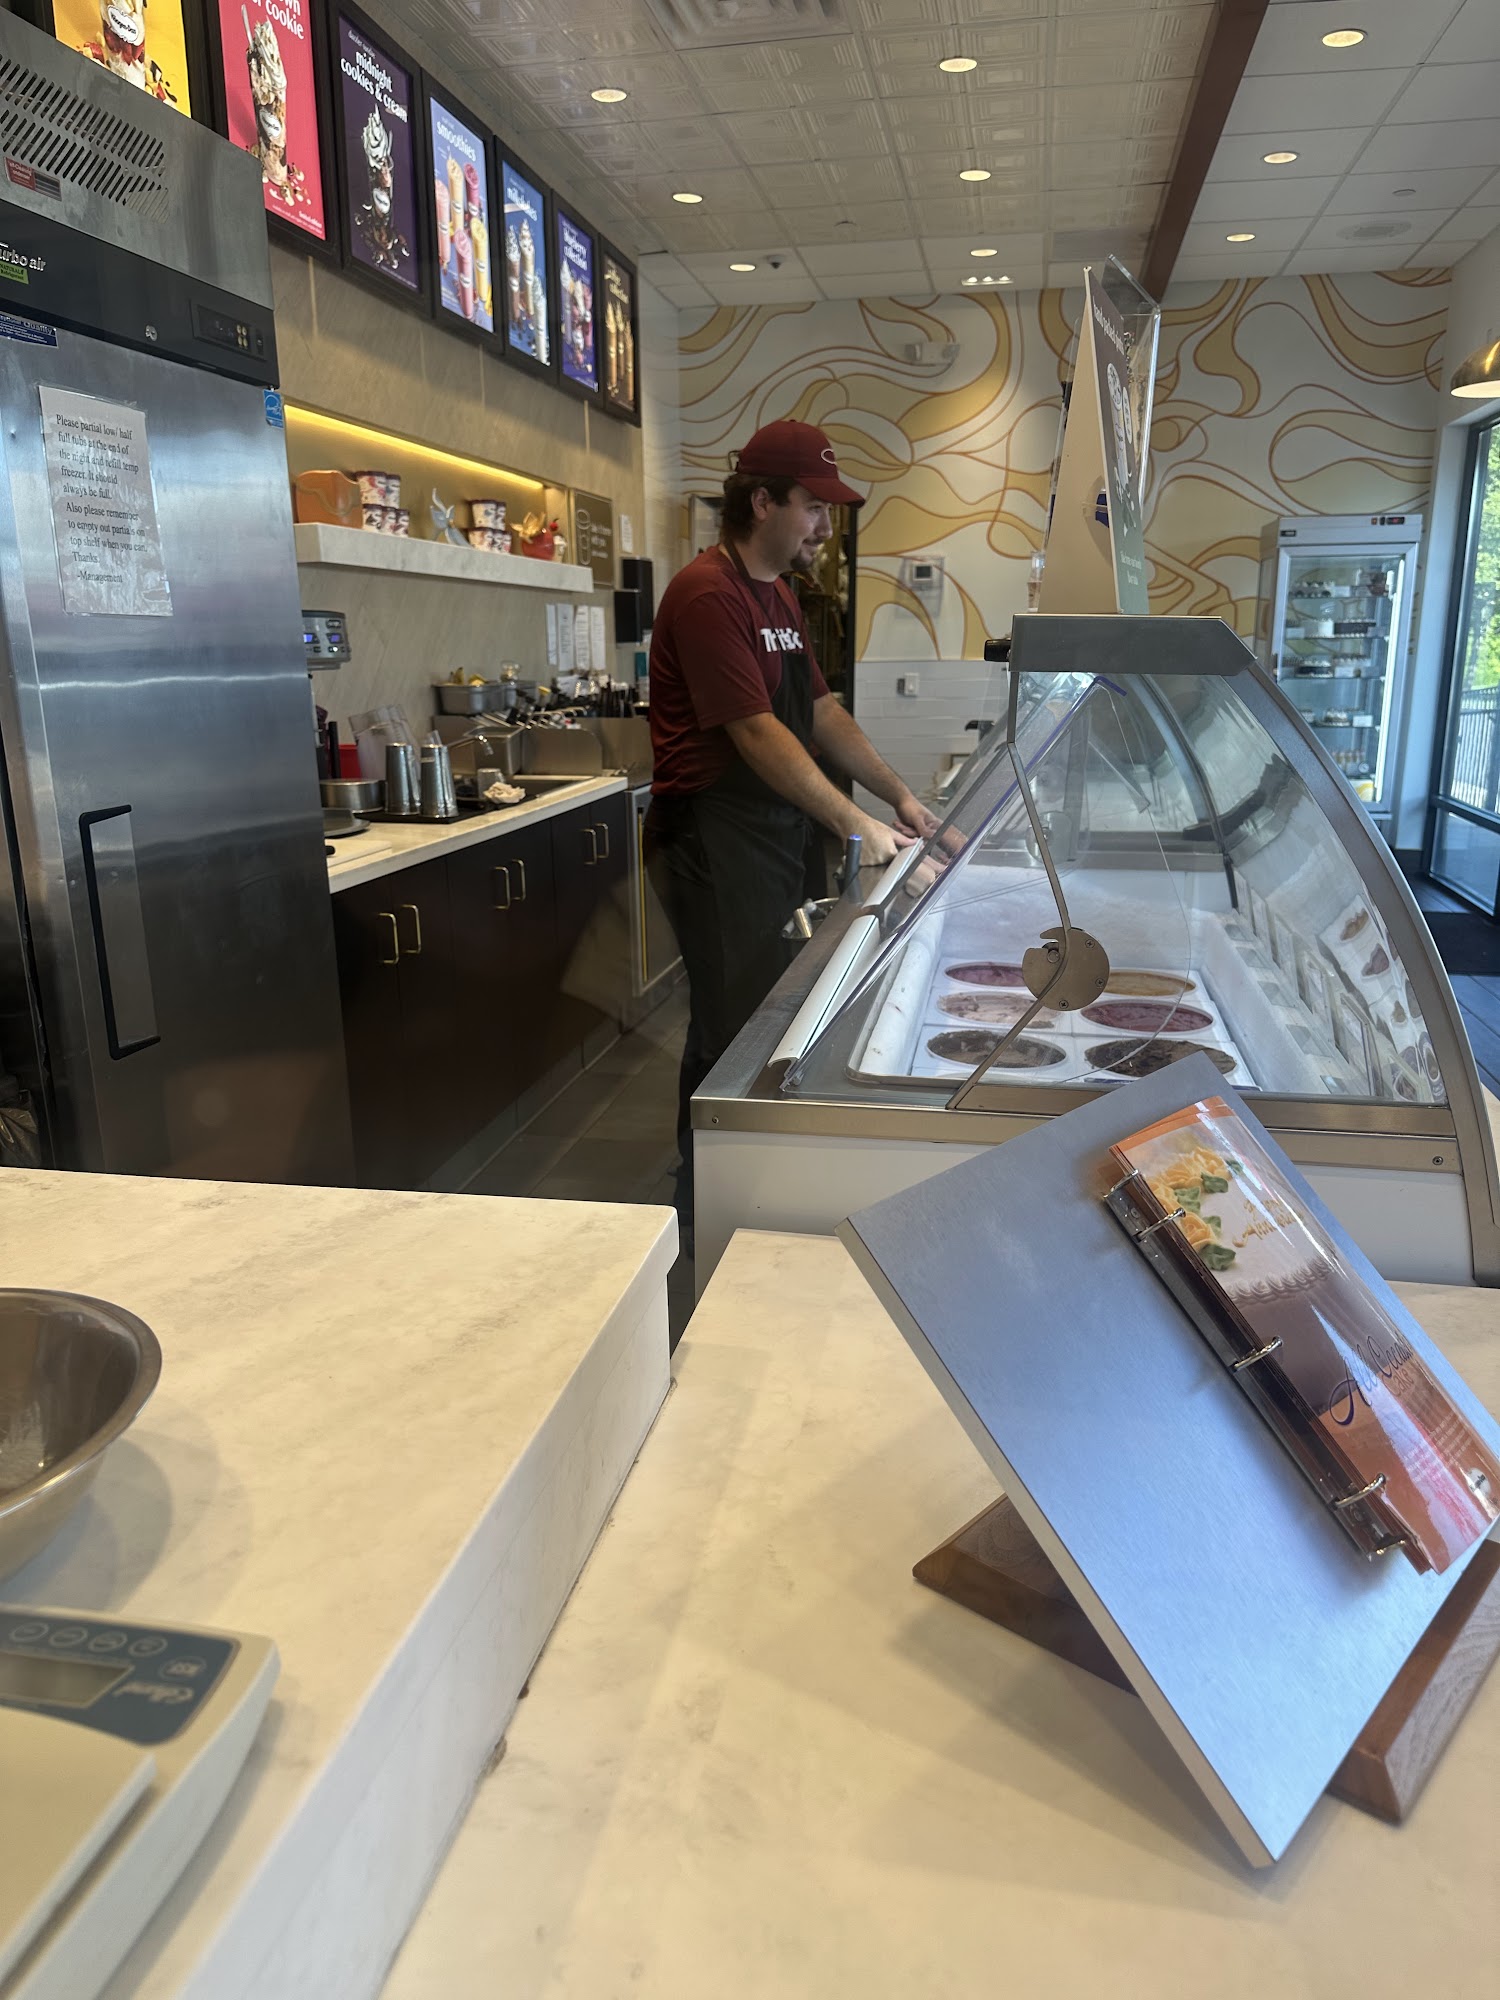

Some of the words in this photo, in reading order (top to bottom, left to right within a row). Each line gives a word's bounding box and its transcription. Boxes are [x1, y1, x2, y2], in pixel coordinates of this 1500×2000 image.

[265, 0, 304, 39] cookie
[356, 51, 393, 92] midnight
[340, 58, 374, 95] cookies
[374, 83, 383, 102] &
[383, 94, 408, 123] cream
[436, 121, 477, 162] smoothies
[0, 242, 28, 267] urbo
[29, 256, 47, 271] air
[56, 414, 79, 429] Please
[81, 422, 102, 434] partial
[119, 427, 133, 440] half
[58, 431, 71, 444] full
[121, 445, 129, 455] of
[59, 449, 71, 460] the
[63, 482, 87, 498] always
[88, 486, 97, 497] be
[66, 502, 82, 513] Also
[84, 504, 105, 516] please
[106, 509, 139, 521] remember
[68, 520, 76, 529] to
[77, 522, 98, 534] empty
[100, 525, 111, 533] out
[70, 536, 82, 547] top
[84, 536, 100, 548] shelf
[101, 539, 119, 549] when
[120, 543, 132, 552] you
[1381, 1367, 1415, 1397] Cake
